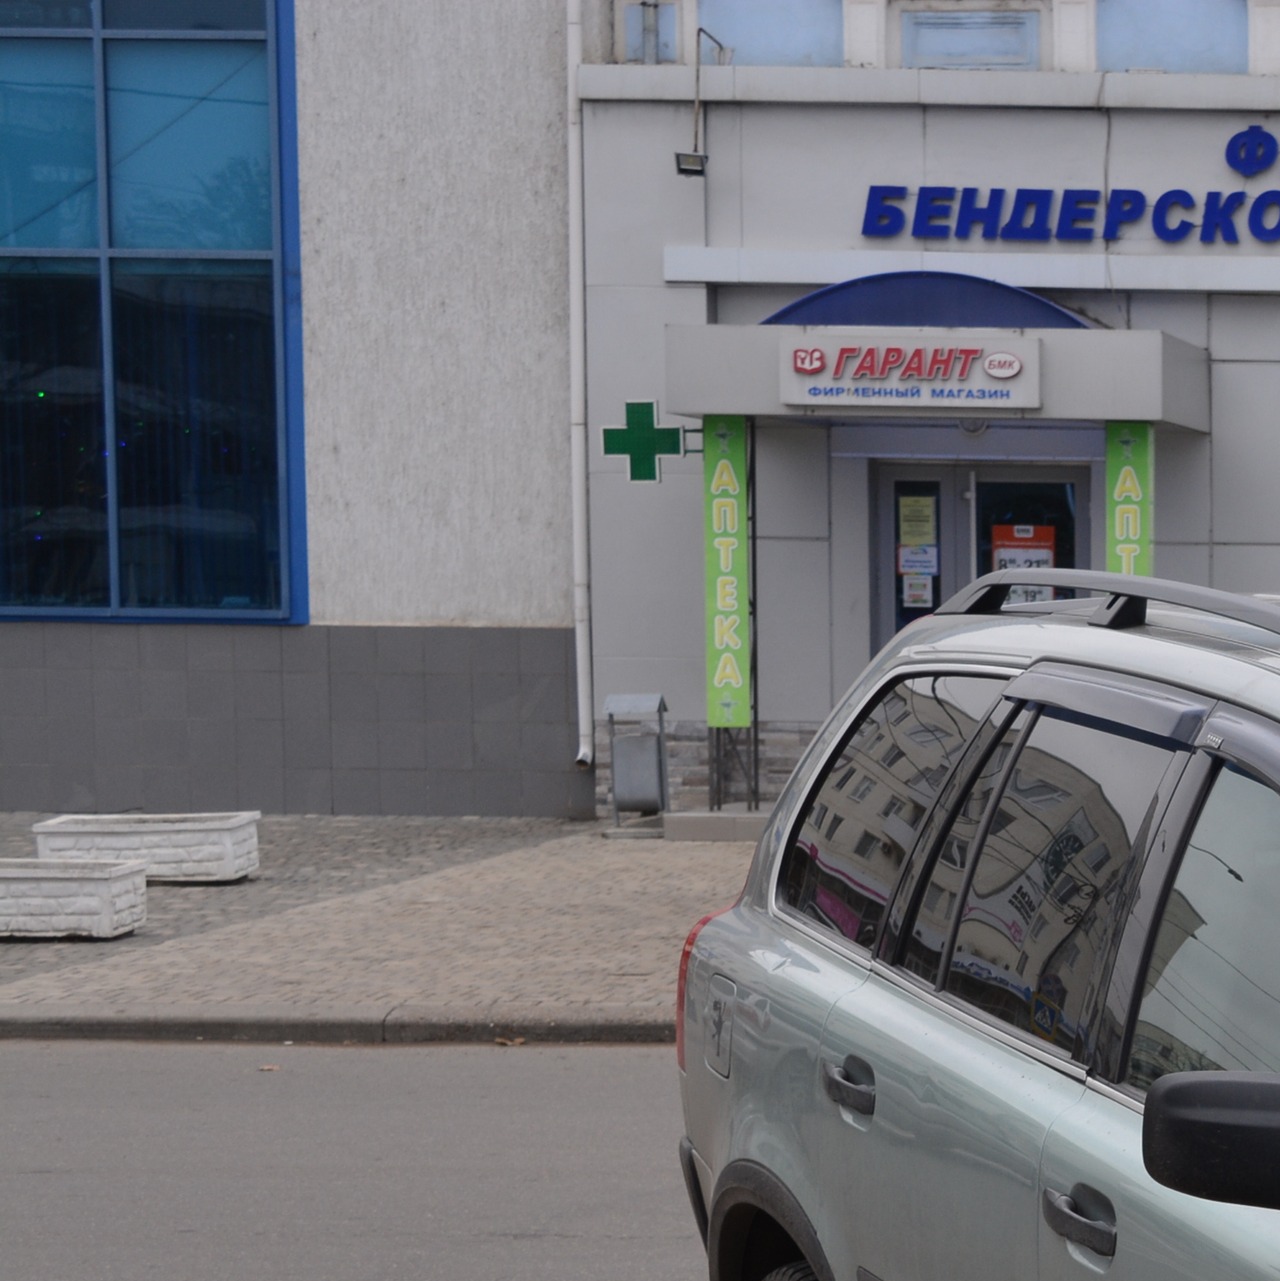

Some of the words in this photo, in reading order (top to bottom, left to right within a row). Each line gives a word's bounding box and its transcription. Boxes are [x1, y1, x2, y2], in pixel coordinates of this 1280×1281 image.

[833, 347, 980, 378] ГАРАНТ
[987, 359, 1016, 371] БМК
[808, 386, 921, 398] ФИРМЕННЫЙ
[931, 388, 1010, 399] МАГАЗИН
[710, 459, 742, 688] АПТЕКА
